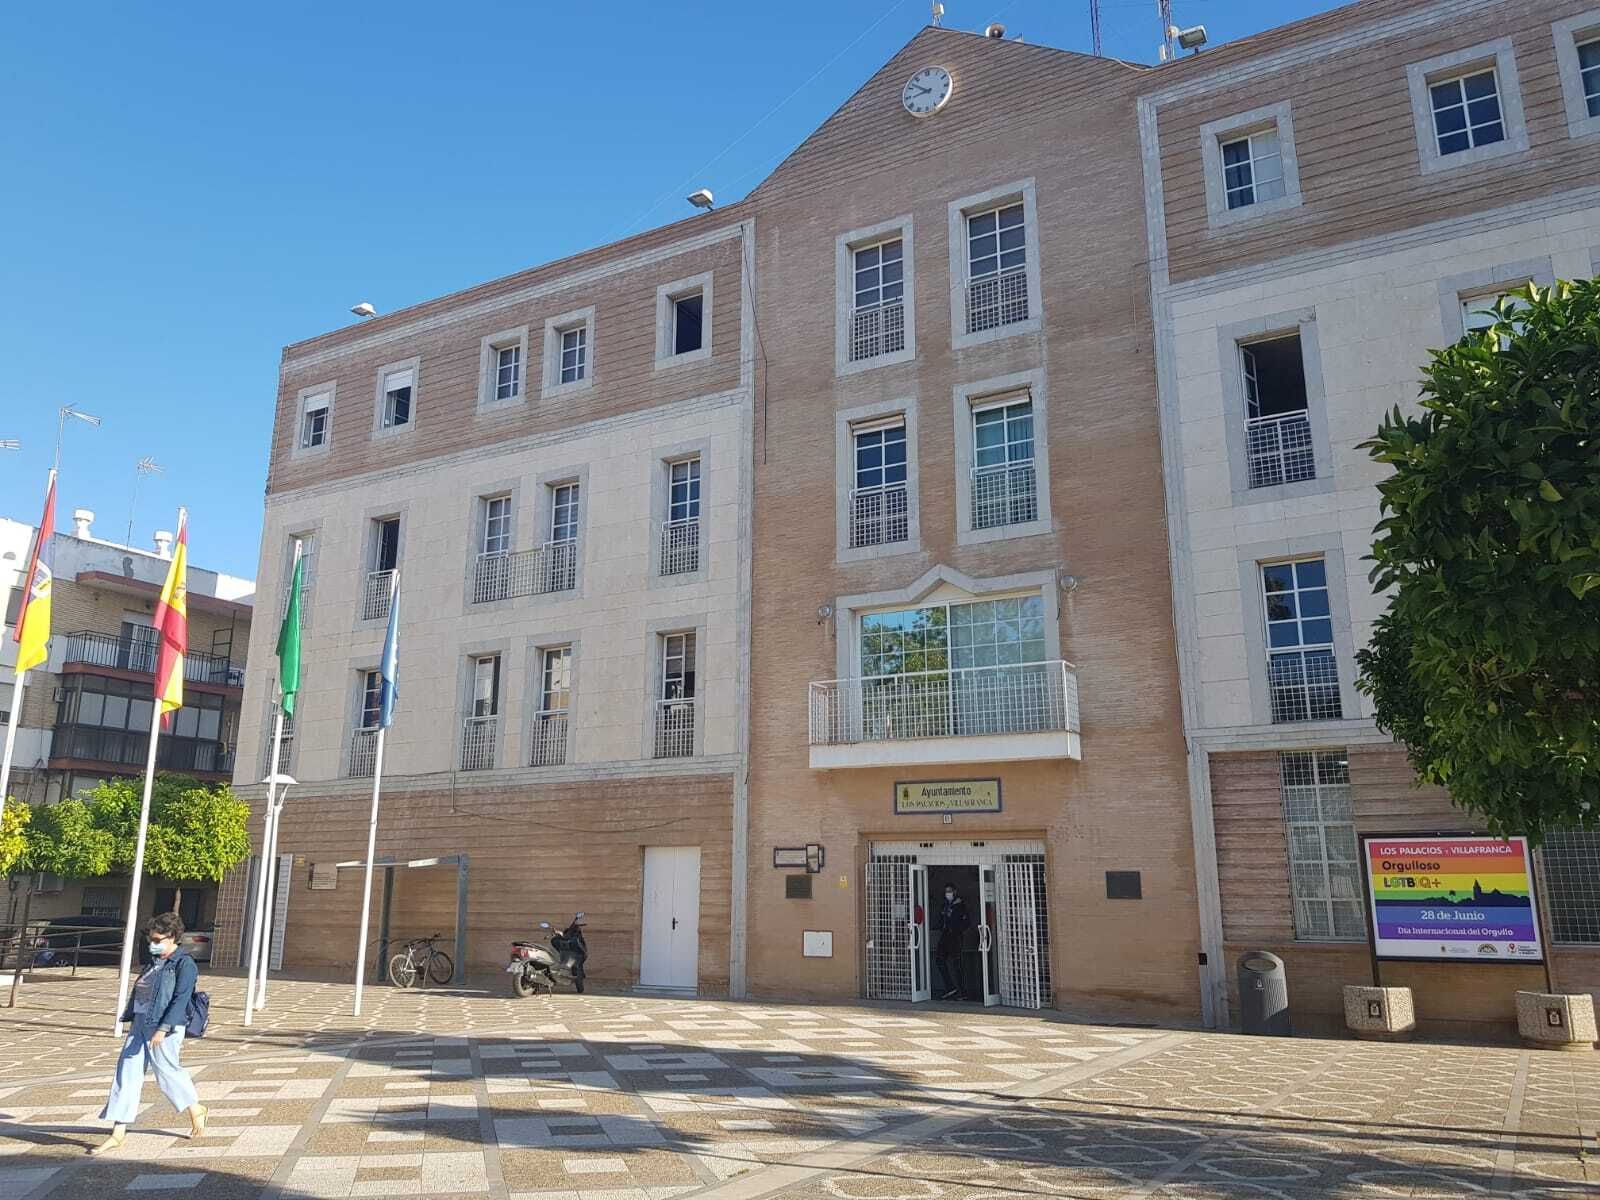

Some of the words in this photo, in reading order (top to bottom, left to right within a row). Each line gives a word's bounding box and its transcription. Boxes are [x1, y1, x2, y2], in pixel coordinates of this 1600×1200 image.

[921, 787, 972, 798] Ayuntamiento
[1380, 847, 1397, 855] LOS
[1400, 846, 1442, 855] PALACIOS
[1451, 845, 1512, 854] VILLAFRANCA
[1382, 861, 1440, 872] Orgulloso
[1421, 910, 1435, 920] 28
[1436, 910, 1451, 920] de
[1452, 910, 1485, 920] Junio
[1412, 927, 1466, 935] Internacional
[1467, 927, 1480, 935] del
[1481, 927, 1514, 937] Orgullo
